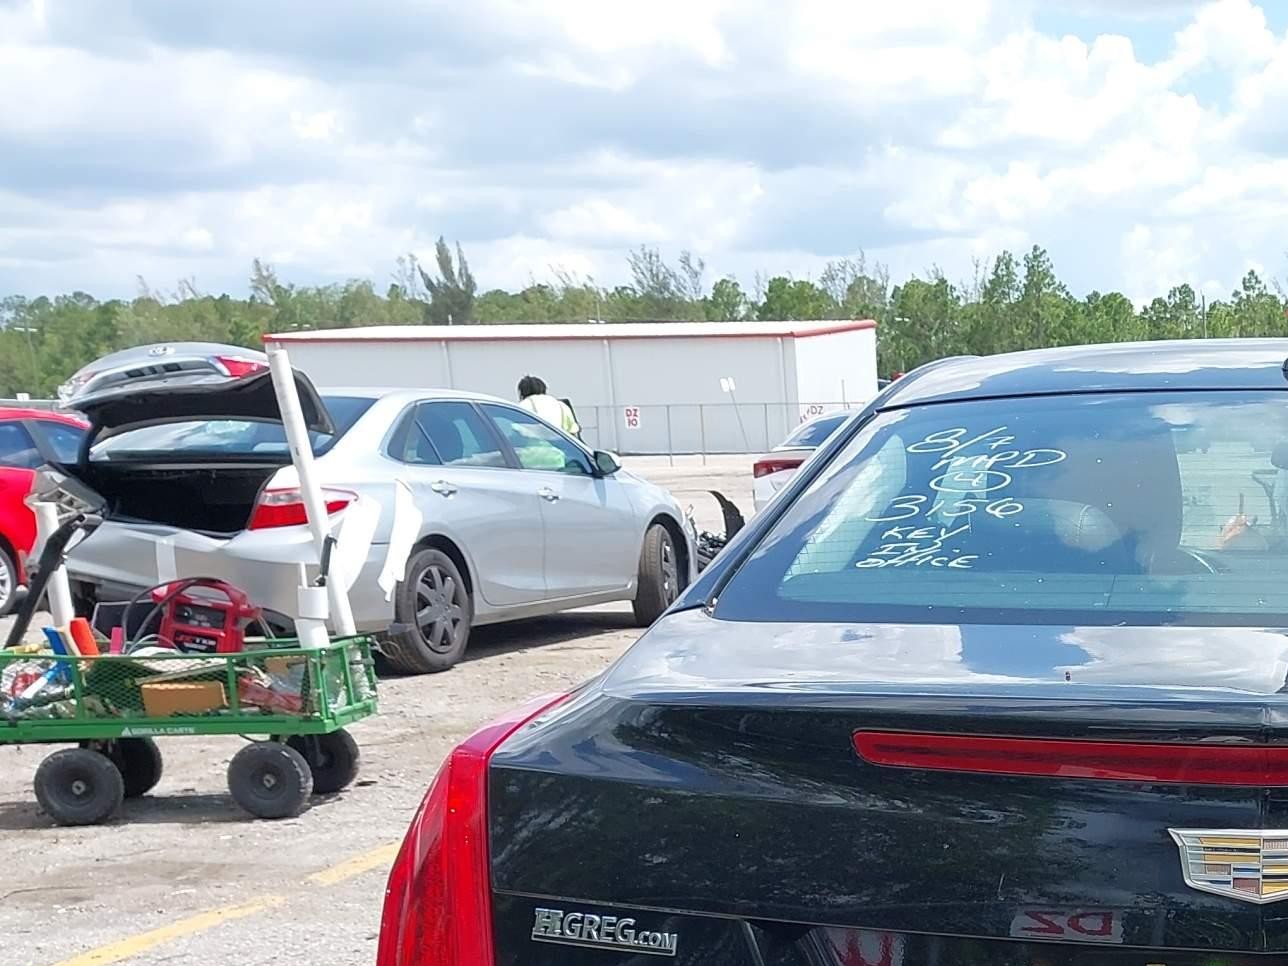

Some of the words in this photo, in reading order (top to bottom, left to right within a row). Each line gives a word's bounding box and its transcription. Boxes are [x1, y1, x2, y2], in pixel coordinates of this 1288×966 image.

[625, 408, 639, 418] DZ
[864, 494, 1024, 522] 3156
[881, 524, 970, 541] KEY
